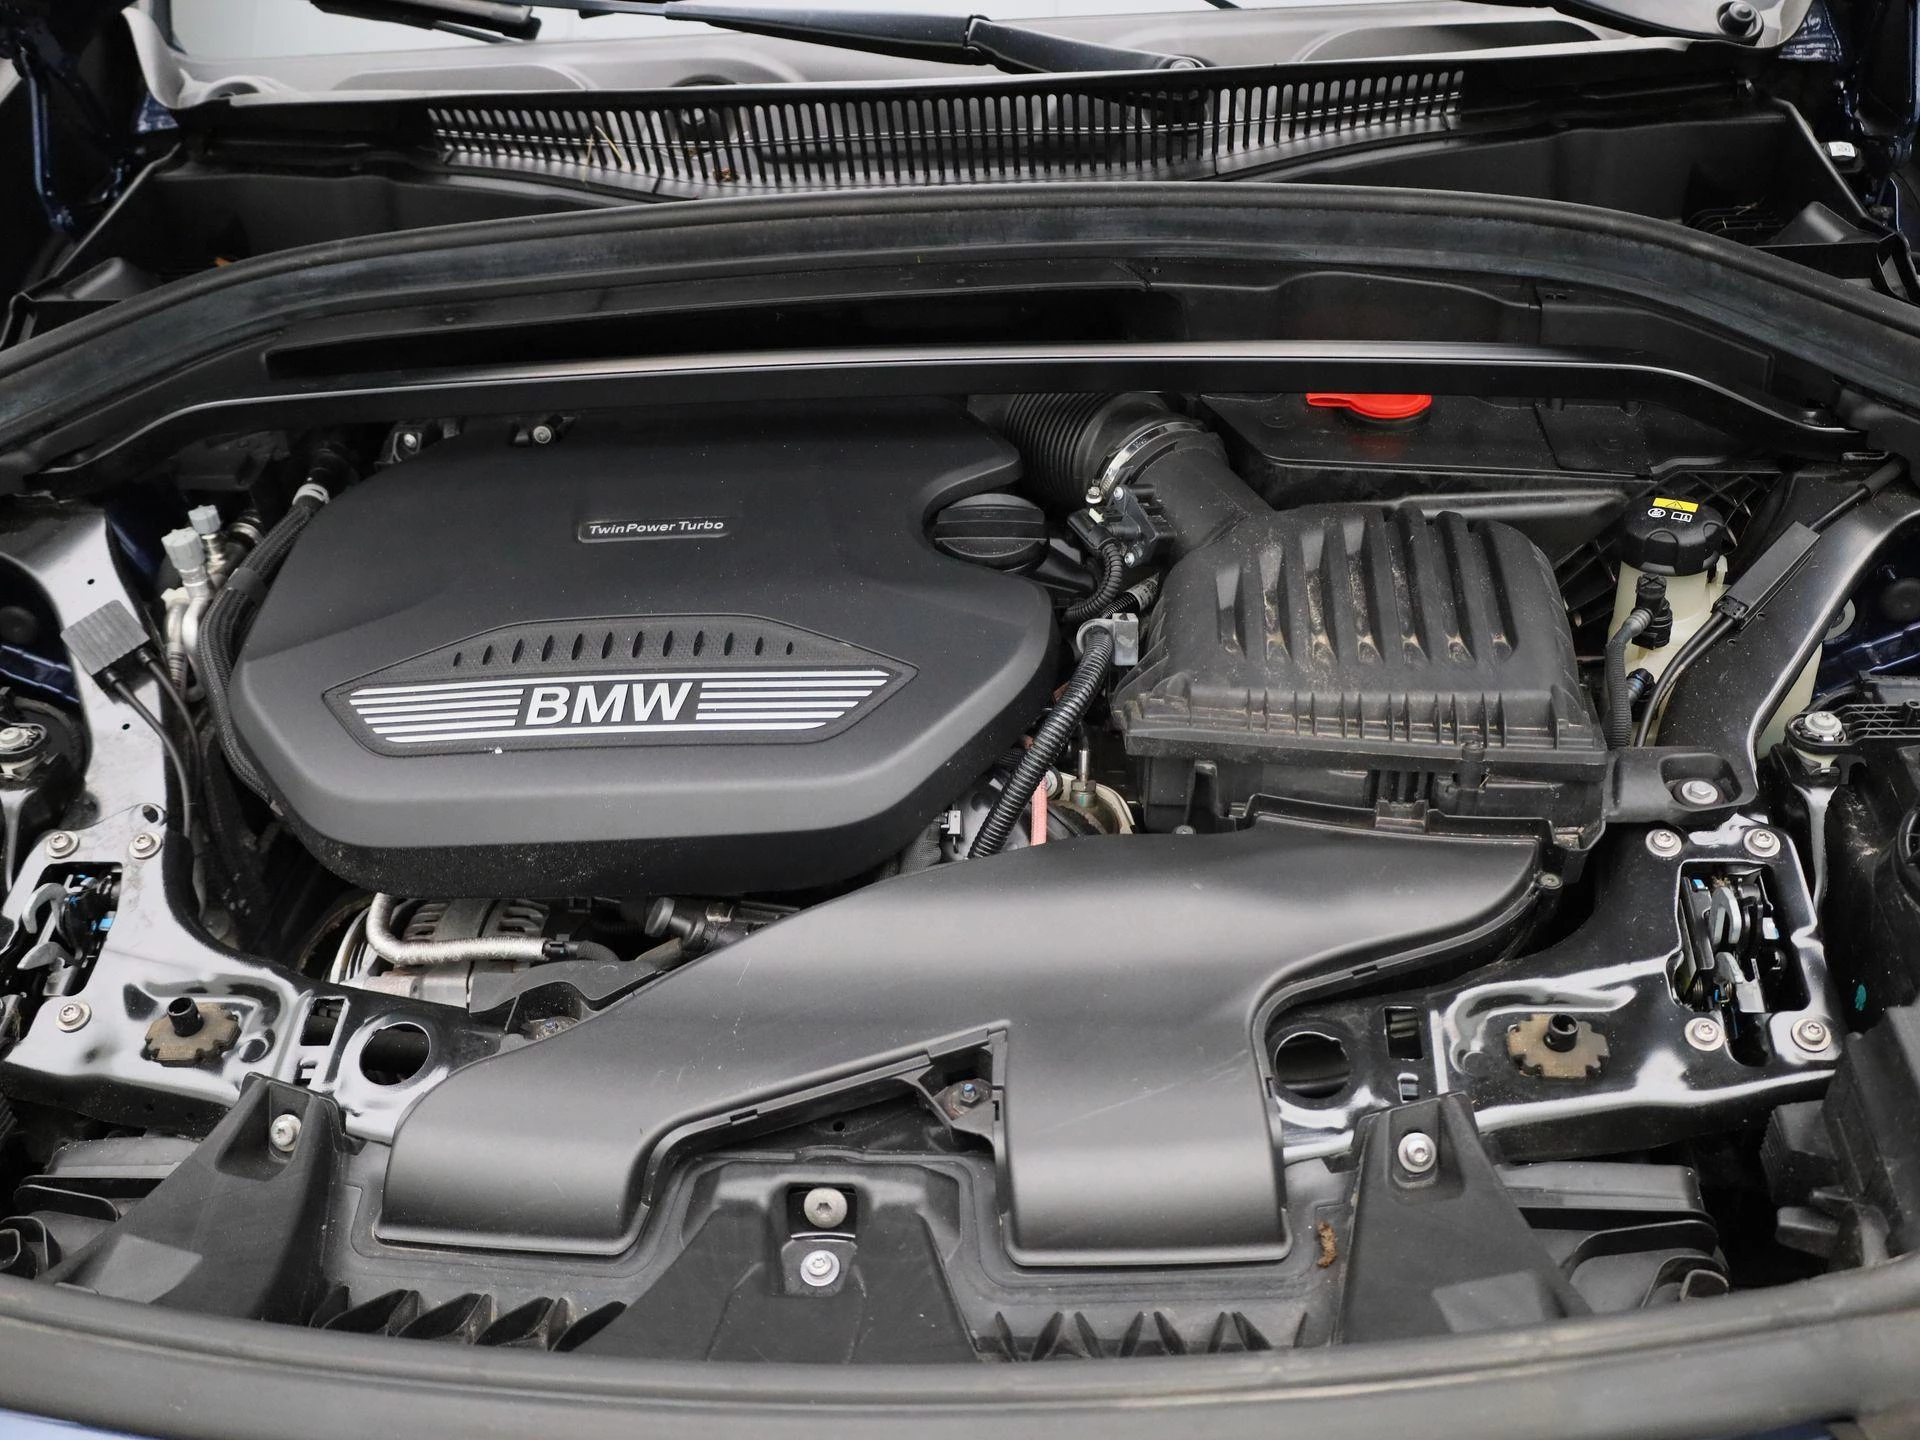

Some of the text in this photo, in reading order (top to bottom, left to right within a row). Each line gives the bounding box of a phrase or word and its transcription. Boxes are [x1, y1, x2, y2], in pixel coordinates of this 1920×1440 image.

[589, 520, 724, 534] TwinPower Turbo
[525, 682, 693, 725] BMW
